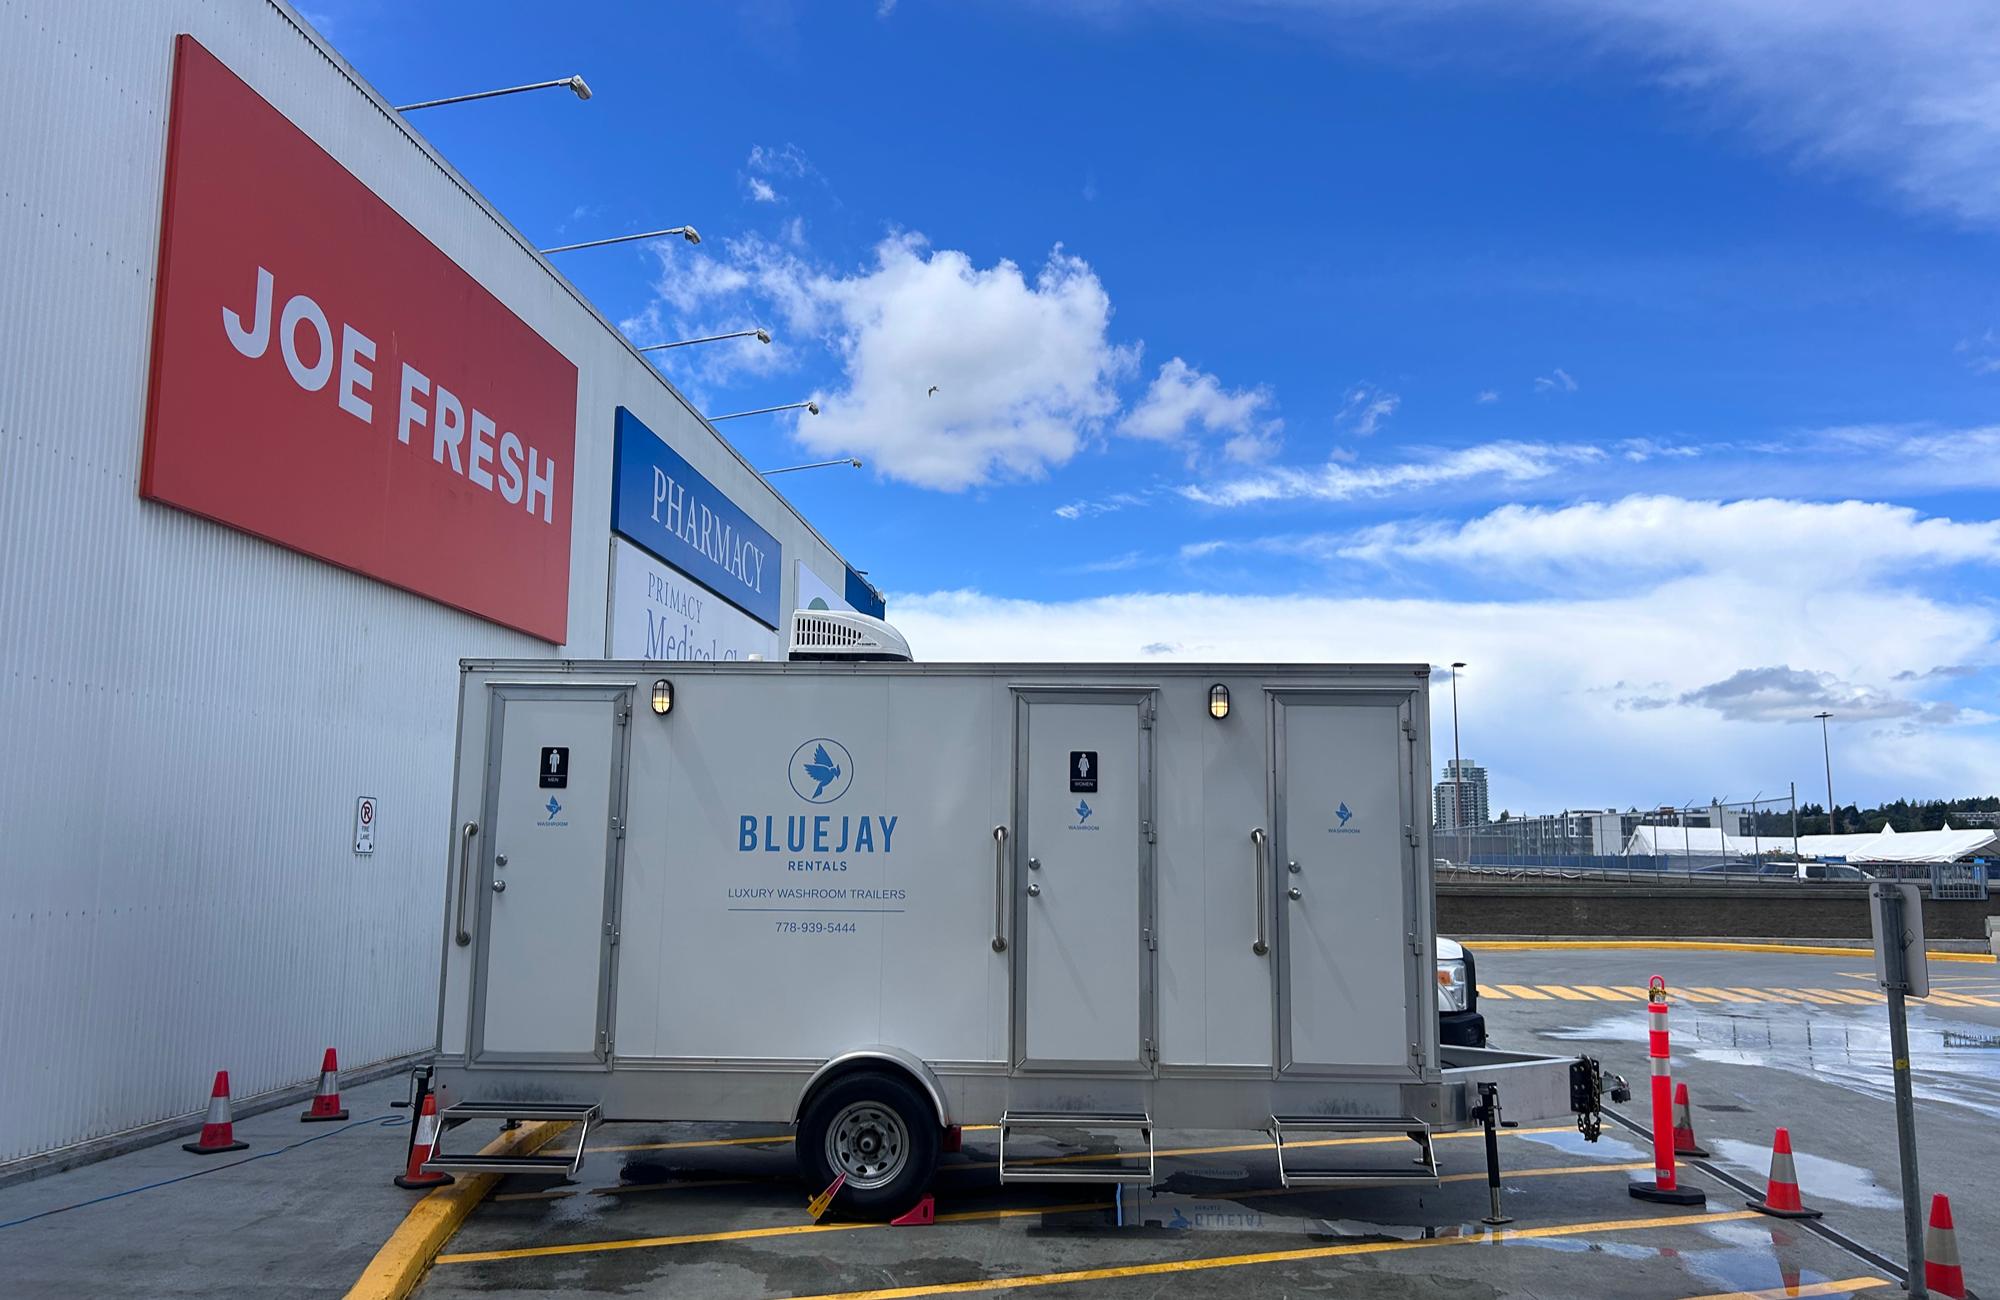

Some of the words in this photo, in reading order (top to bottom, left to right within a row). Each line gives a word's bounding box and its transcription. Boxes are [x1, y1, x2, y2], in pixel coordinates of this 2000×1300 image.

[223, 265, 377, 424] JOE
[398, 362, 555, 524] FRESH
[651, 464, 765, 594] PHARMACY
[648, 571, 703, 623] PRIMACY
[644, 608, 716, 660] Medi
[738, 815, 899, 853] BLUEJAY
[787, 860, 848, 871] RENTALS
[728, 888, 774, 899] LUXURY
[777, 889, 847, 900] WASHROOM
[850, 889, 906, 900] TRAILERS
[775, 922, 857, 934] 778-939-5444
